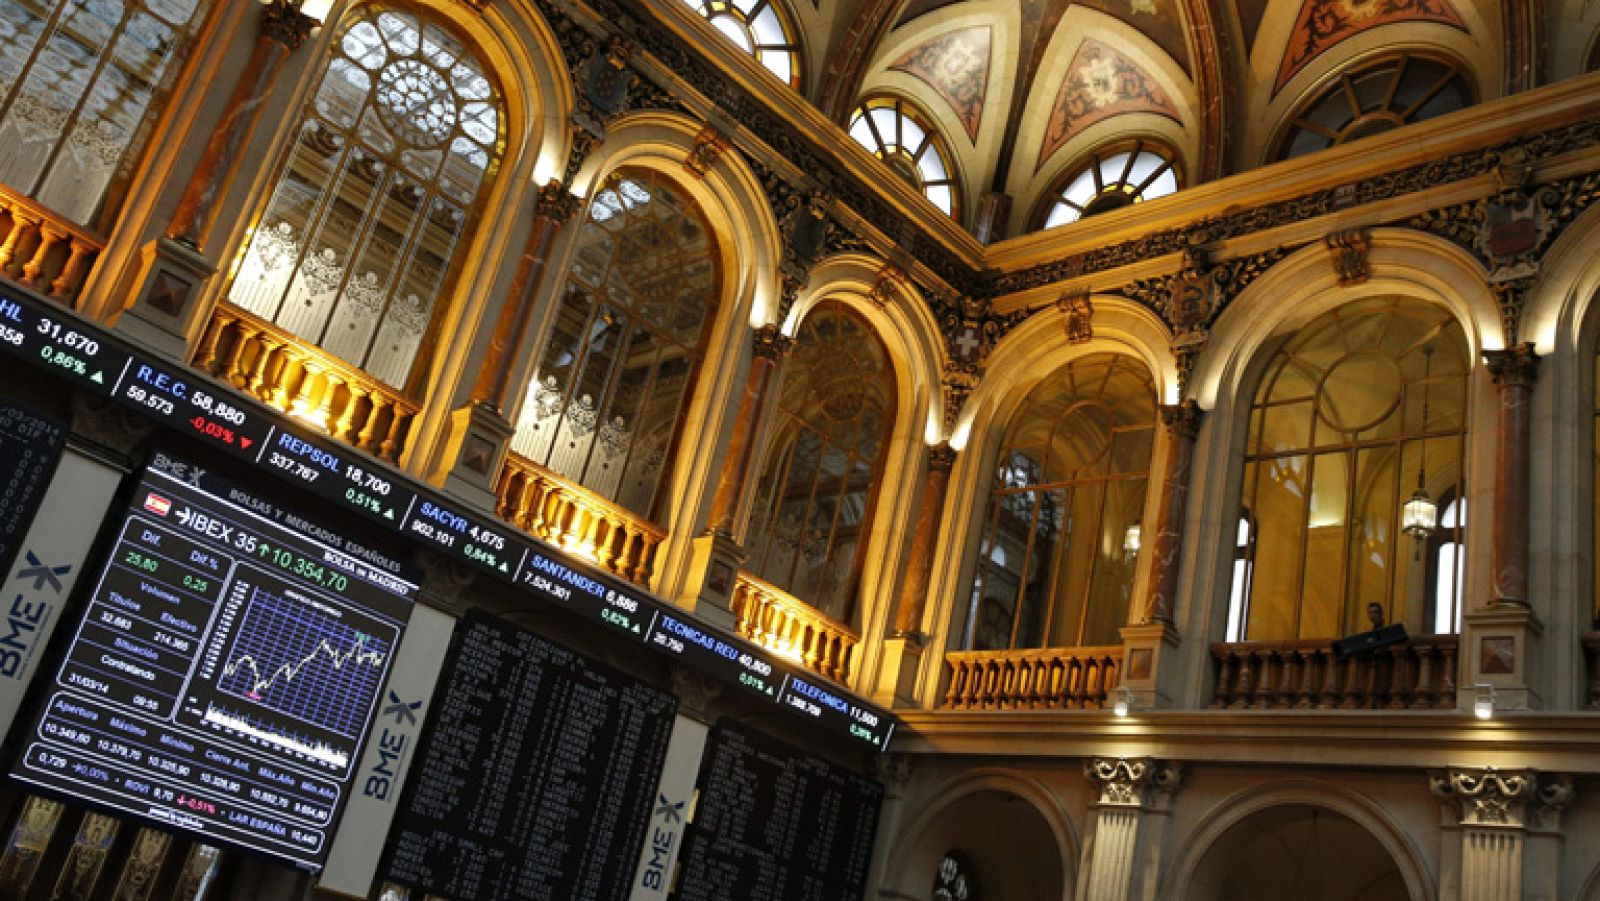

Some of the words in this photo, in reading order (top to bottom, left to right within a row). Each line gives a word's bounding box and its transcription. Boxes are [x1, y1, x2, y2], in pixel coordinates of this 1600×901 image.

[36, 318, 99, 356] 31,670
[136, 364, 187, 400] R.E.C.
[278, 433, 339, 473] REPSOL
[345, 464, 391, 495] 18,700
[345, 487, 381, 514] 0,51%
[420, 502, 467, 533] SACYR
[188, 512, 235, 543] IBEX
[234, 531, 259, 554] 35
[273, 546, 348, 592] 10.354,70
[229, 487, 272, 515] BOLSAS
[274, 508, 284, 519] Y
[285, 514, 342, 547] MERCADOS
[345, 540, 401, 573] ESPAÑOLES
[531, 554, 605, 598] SANTANDER
[0, 593, 47, 678] BME
[662, 615, 715, 650] TECNICAS
[715, 641, 739, 660] REU
[791, 677, 849, 714] TELEFONICA
[363, 727, 405, 801] BME
[642, 826, 673, 890] BME
